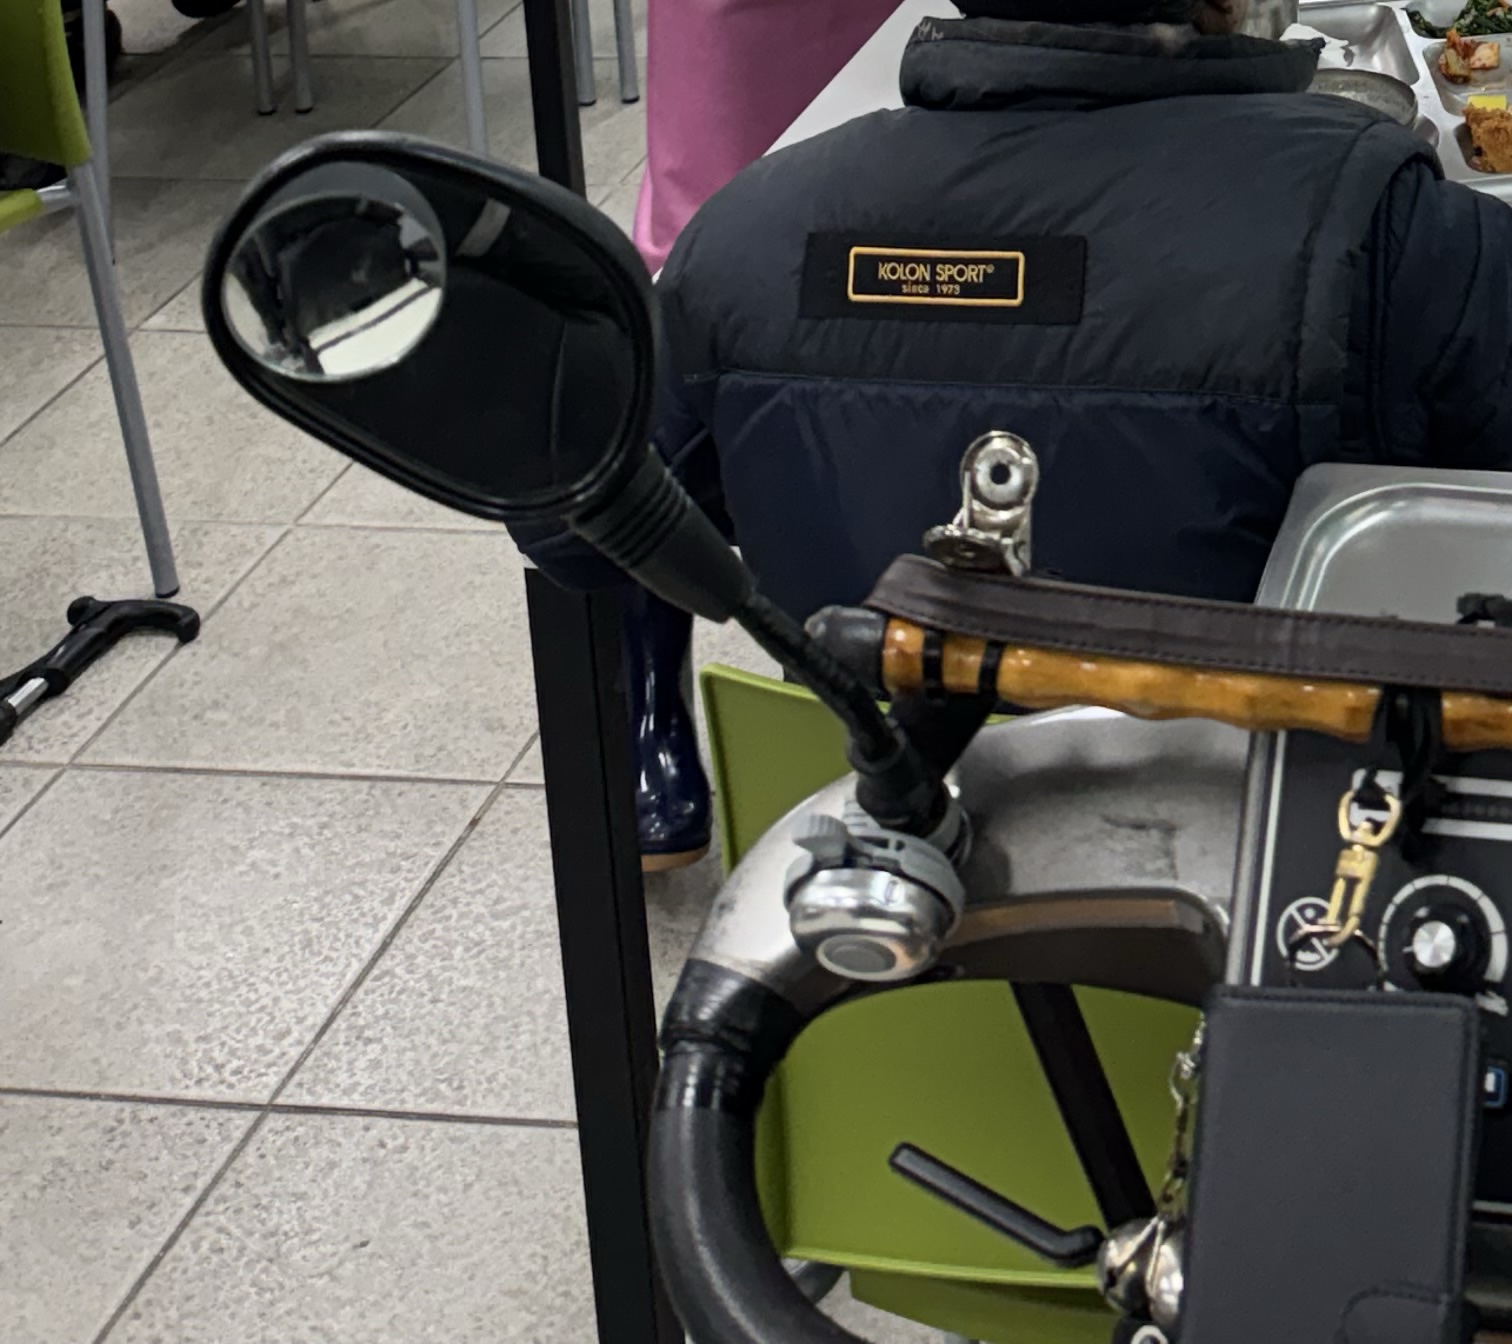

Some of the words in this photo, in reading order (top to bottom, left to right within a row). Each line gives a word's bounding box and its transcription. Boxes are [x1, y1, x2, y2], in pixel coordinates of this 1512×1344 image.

[878, 262, 931, 281] KOLON
[901, 281, 930, 294] since
[935, 283, 961, 295] 1973
